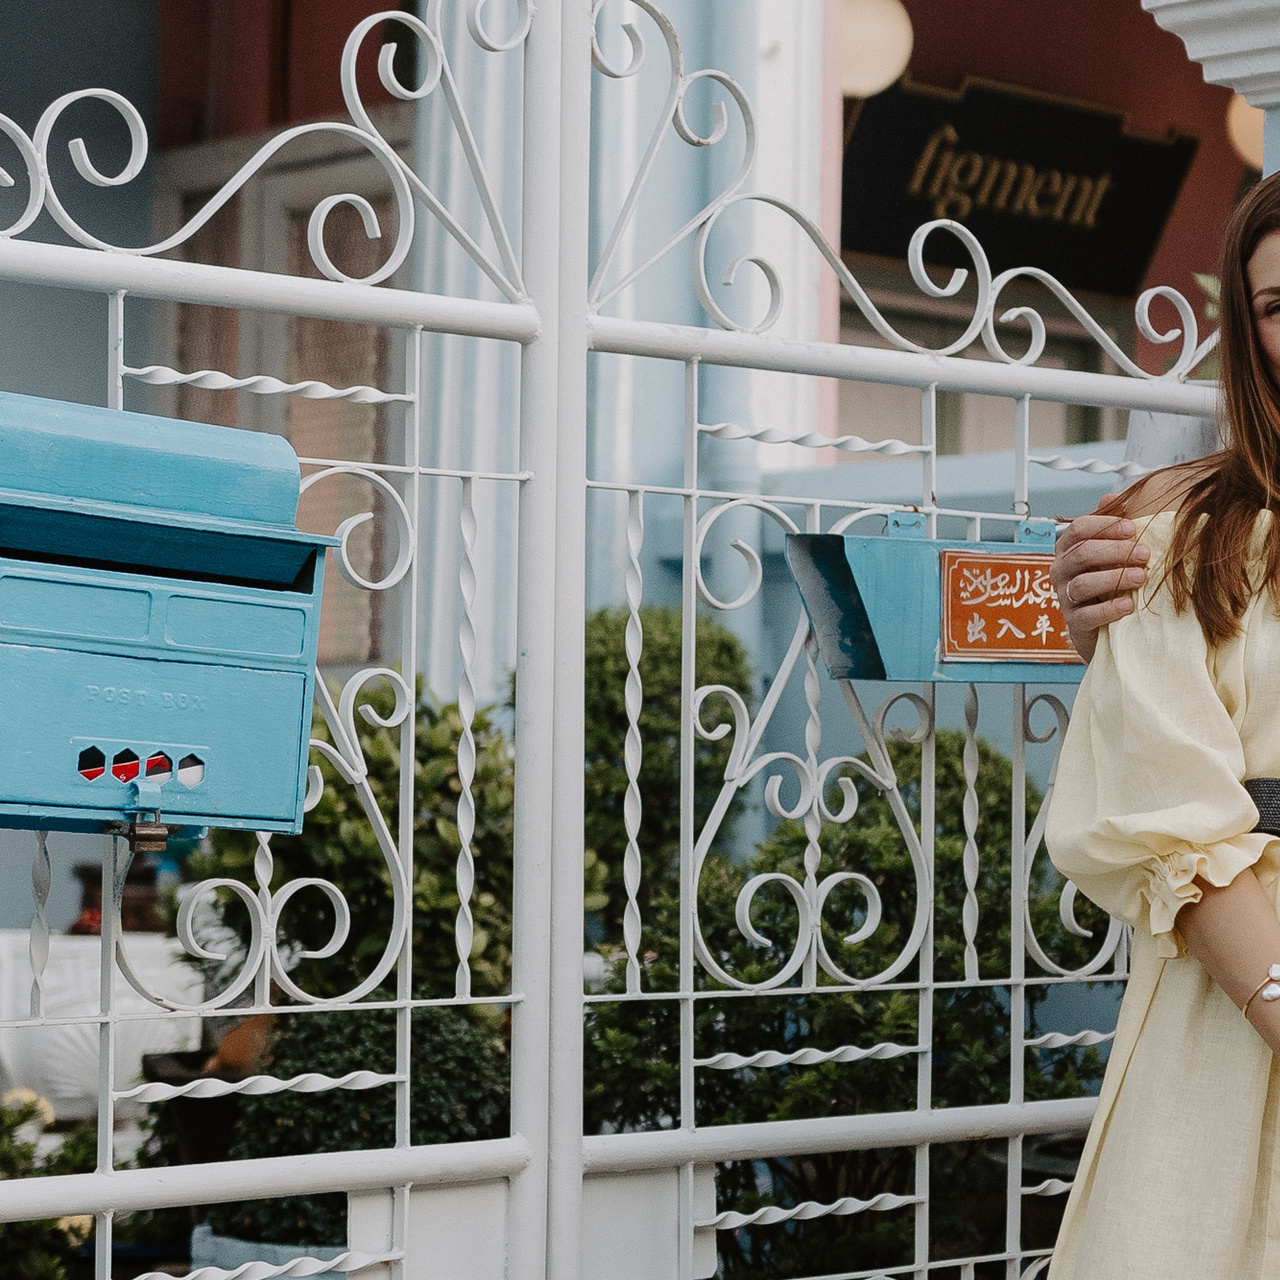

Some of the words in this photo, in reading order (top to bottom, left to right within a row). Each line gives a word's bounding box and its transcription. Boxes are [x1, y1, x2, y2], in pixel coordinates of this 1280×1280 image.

[908, 123, 1111, 228] figment
[966, 612, 1073, 645] 出入平
[85, 684, 148, 706] POST
[160, 692, 206, 713] BOX
